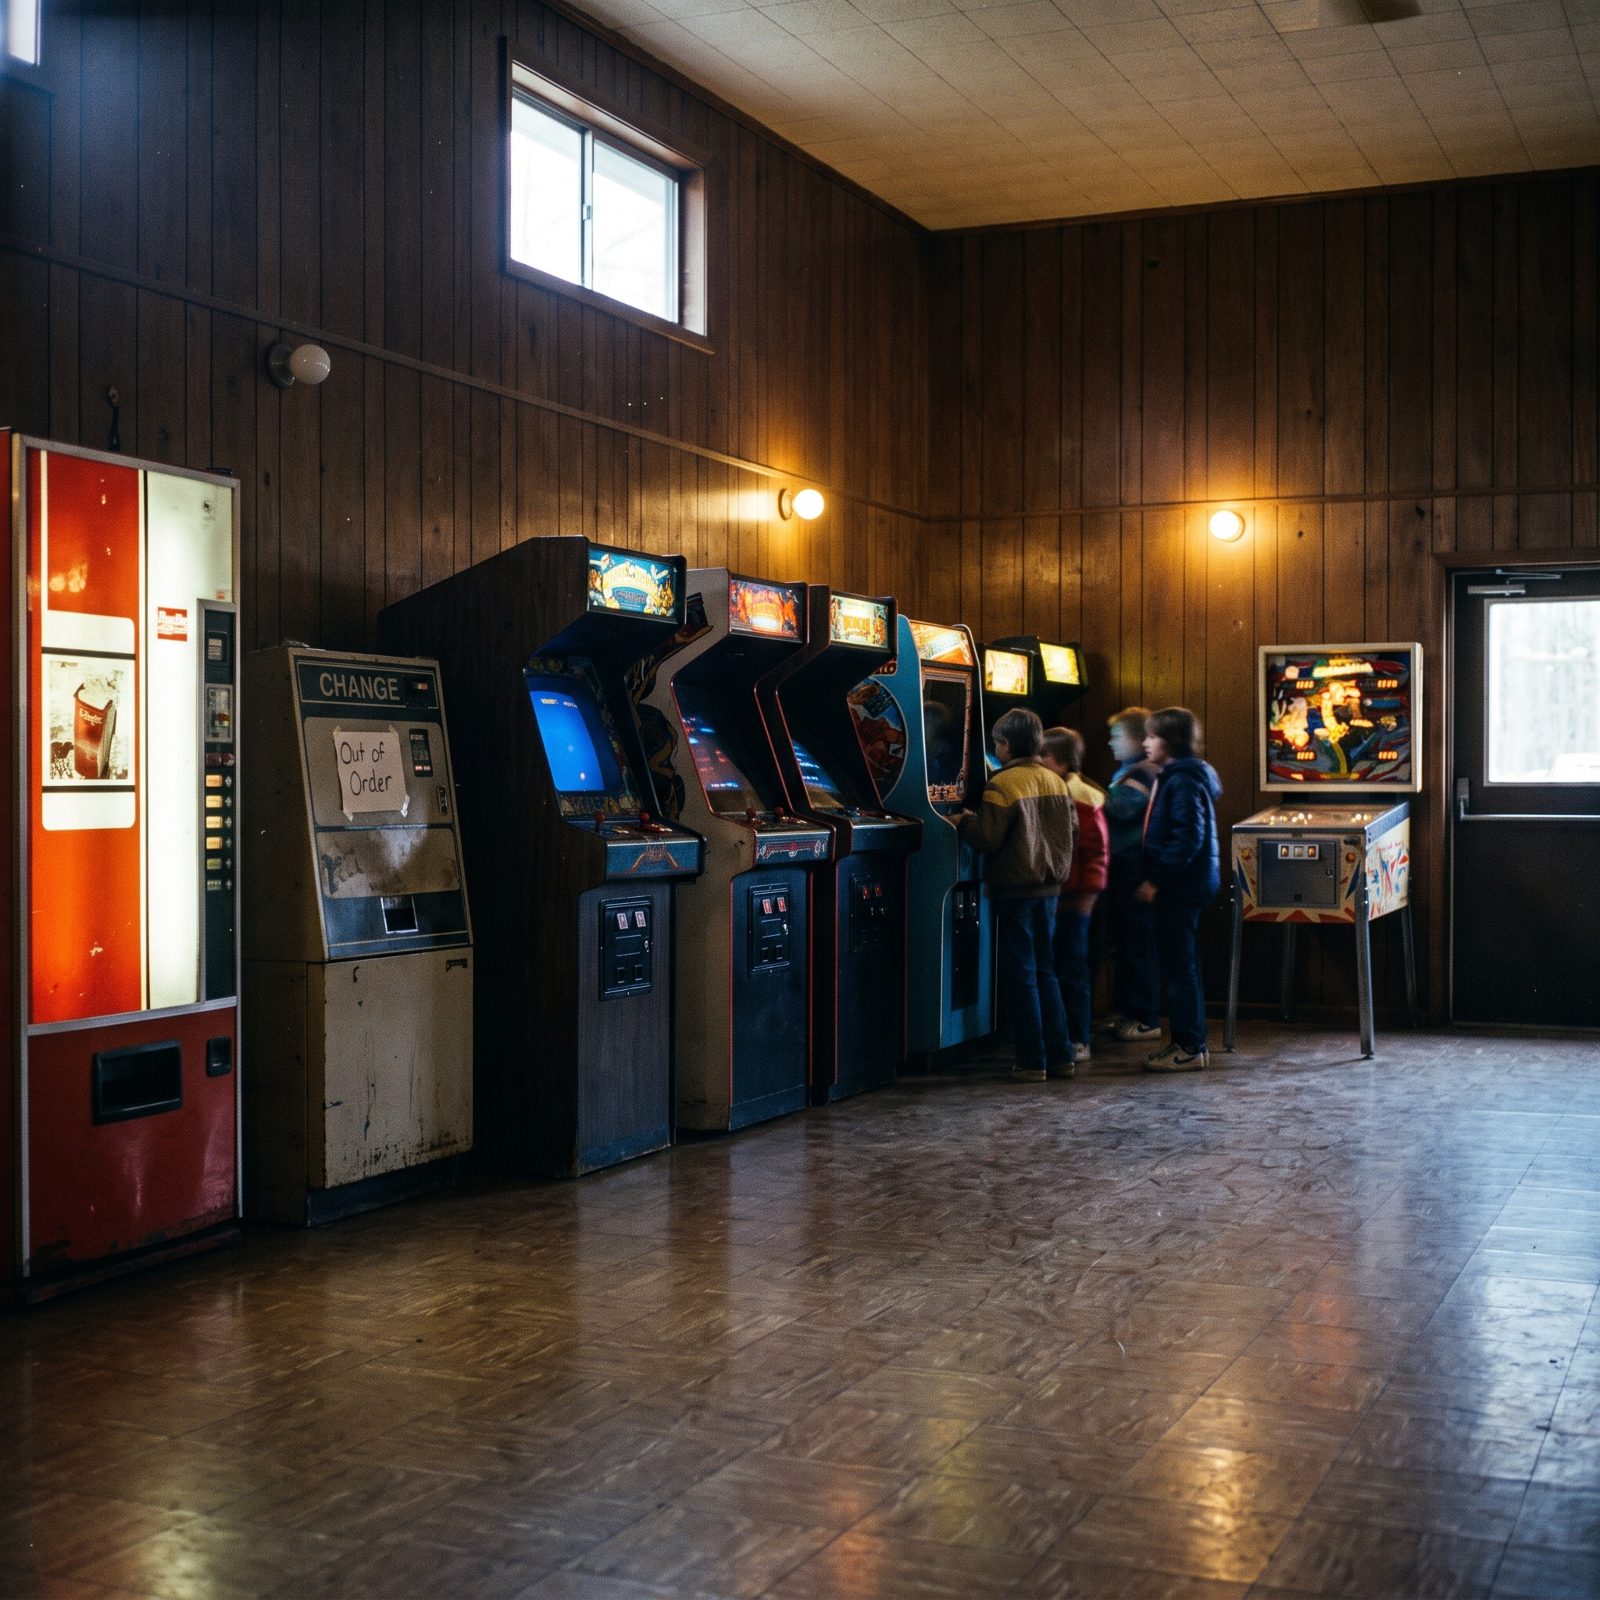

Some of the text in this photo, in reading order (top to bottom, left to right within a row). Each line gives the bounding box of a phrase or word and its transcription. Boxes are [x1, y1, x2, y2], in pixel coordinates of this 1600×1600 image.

[320, 672, 400, 701] CHANGE
[340, 741, 385, 765] Out of
[350, 768, 392, 796] Order
